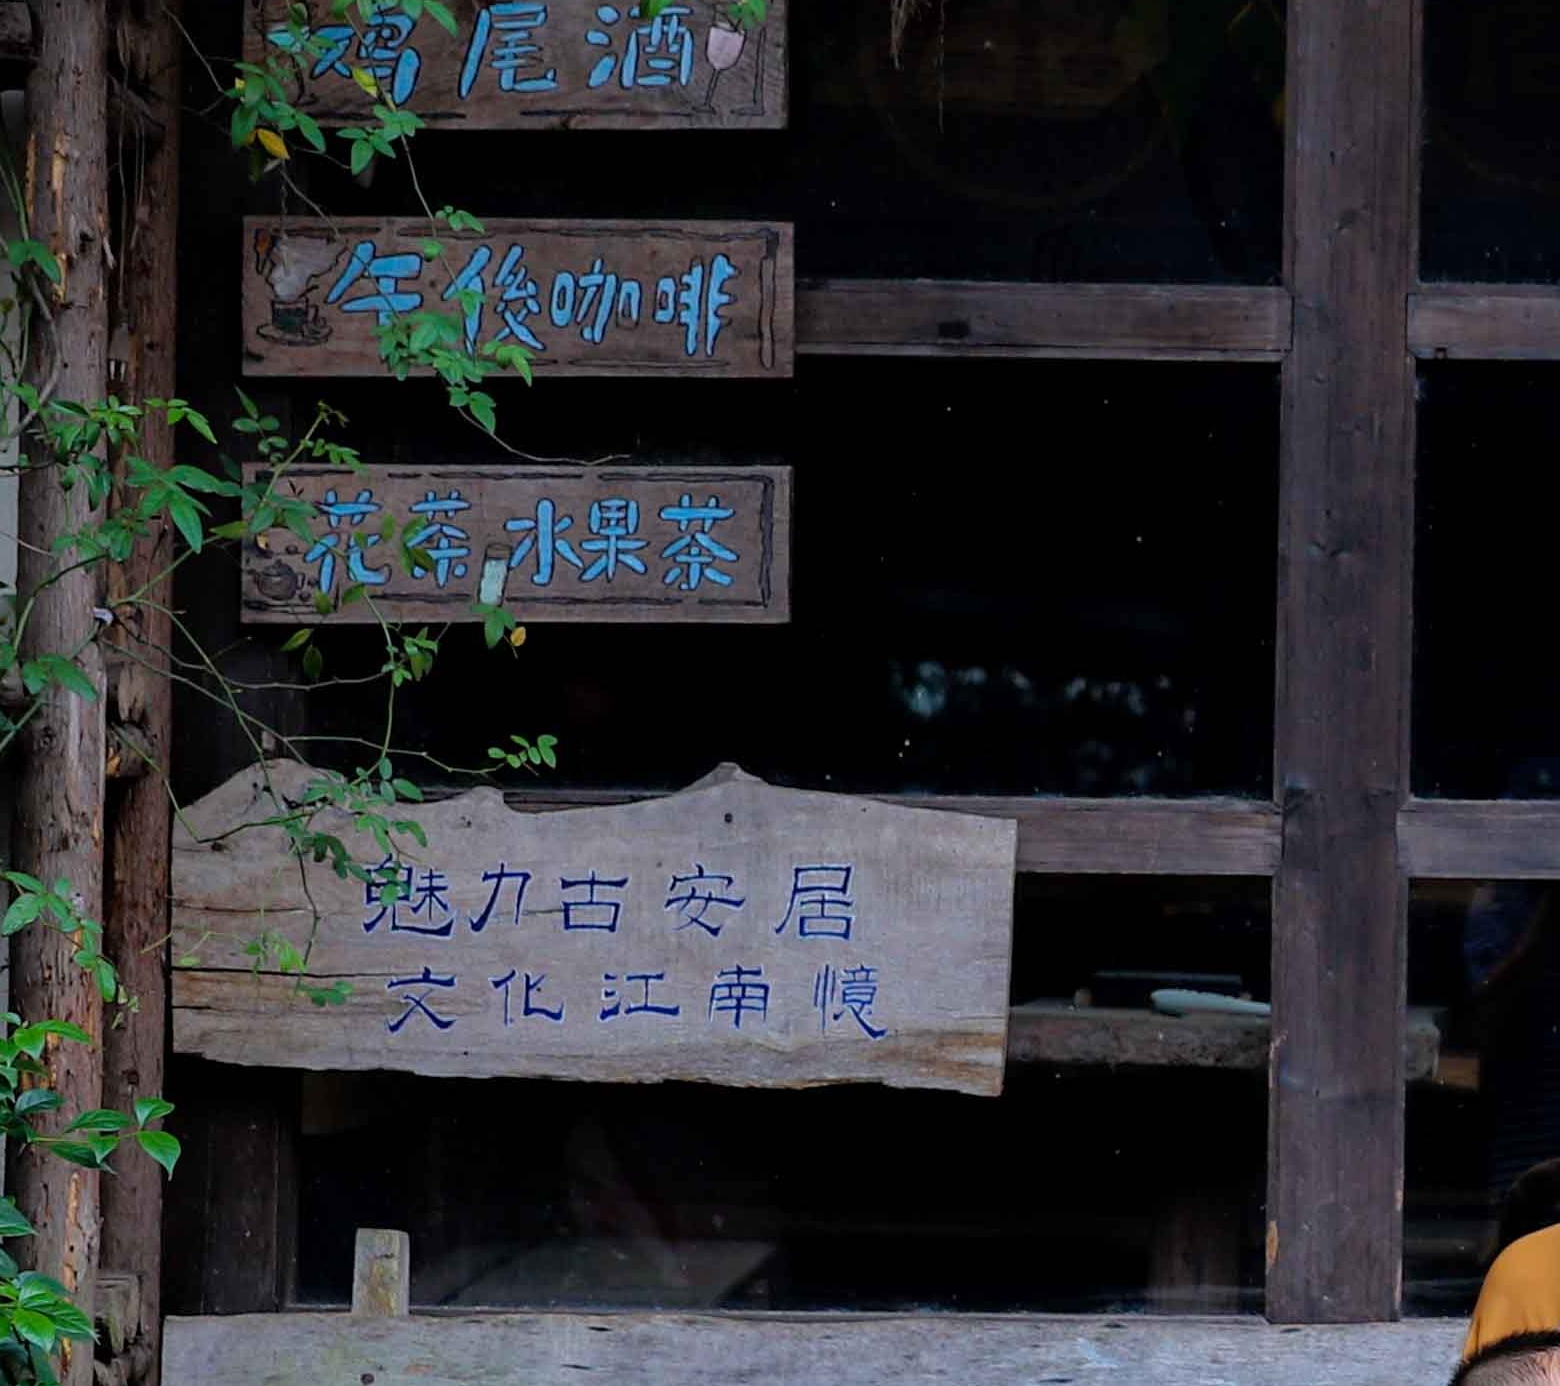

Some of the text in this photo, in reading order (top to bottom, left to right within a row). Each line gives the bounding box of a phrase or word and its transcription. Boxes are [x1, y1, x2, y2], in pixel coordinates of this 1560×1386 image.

[311, 0, 696, 106] 鸡尾酒
[362, 851, 856, 941] 魅力古安居
[385, 963, 889, 1040] 文化江南憶
